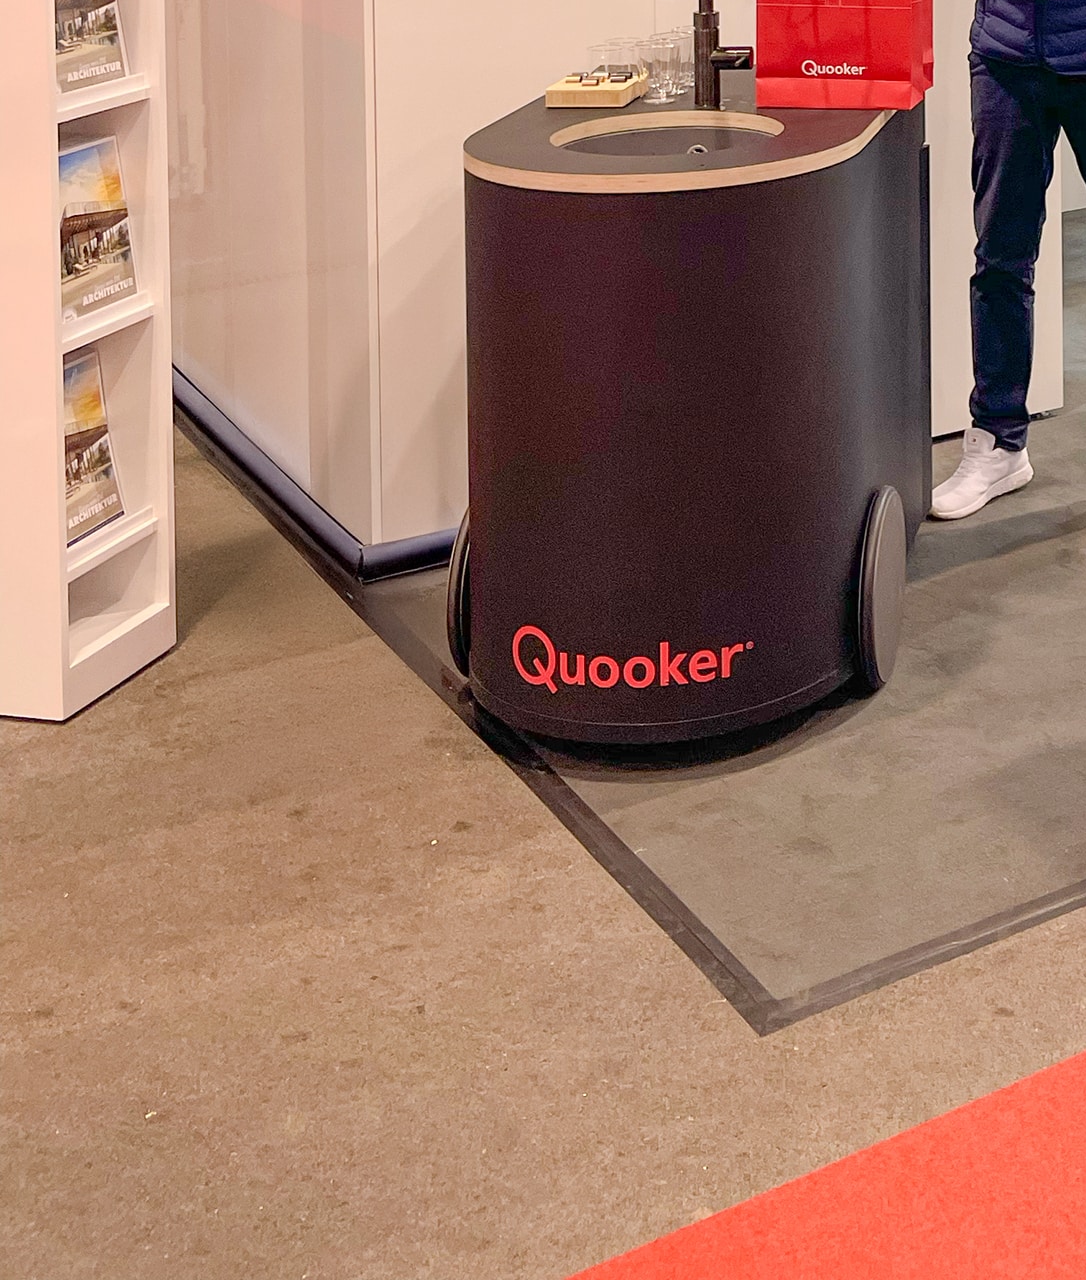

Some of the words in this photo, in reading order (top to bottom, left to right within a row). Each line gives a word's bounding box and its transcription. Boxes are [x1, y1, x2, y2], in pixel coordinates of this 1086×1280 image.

[67, 61, 122, 82] ARCHITEKTUR
[801, 60, 866, 77] Quooker
[82, 277, 134, 306] ARCHITEKTUR
[68, 493, 118, 529] ARCHITEKTUR
[512, 625, 745, 693] Quooker
